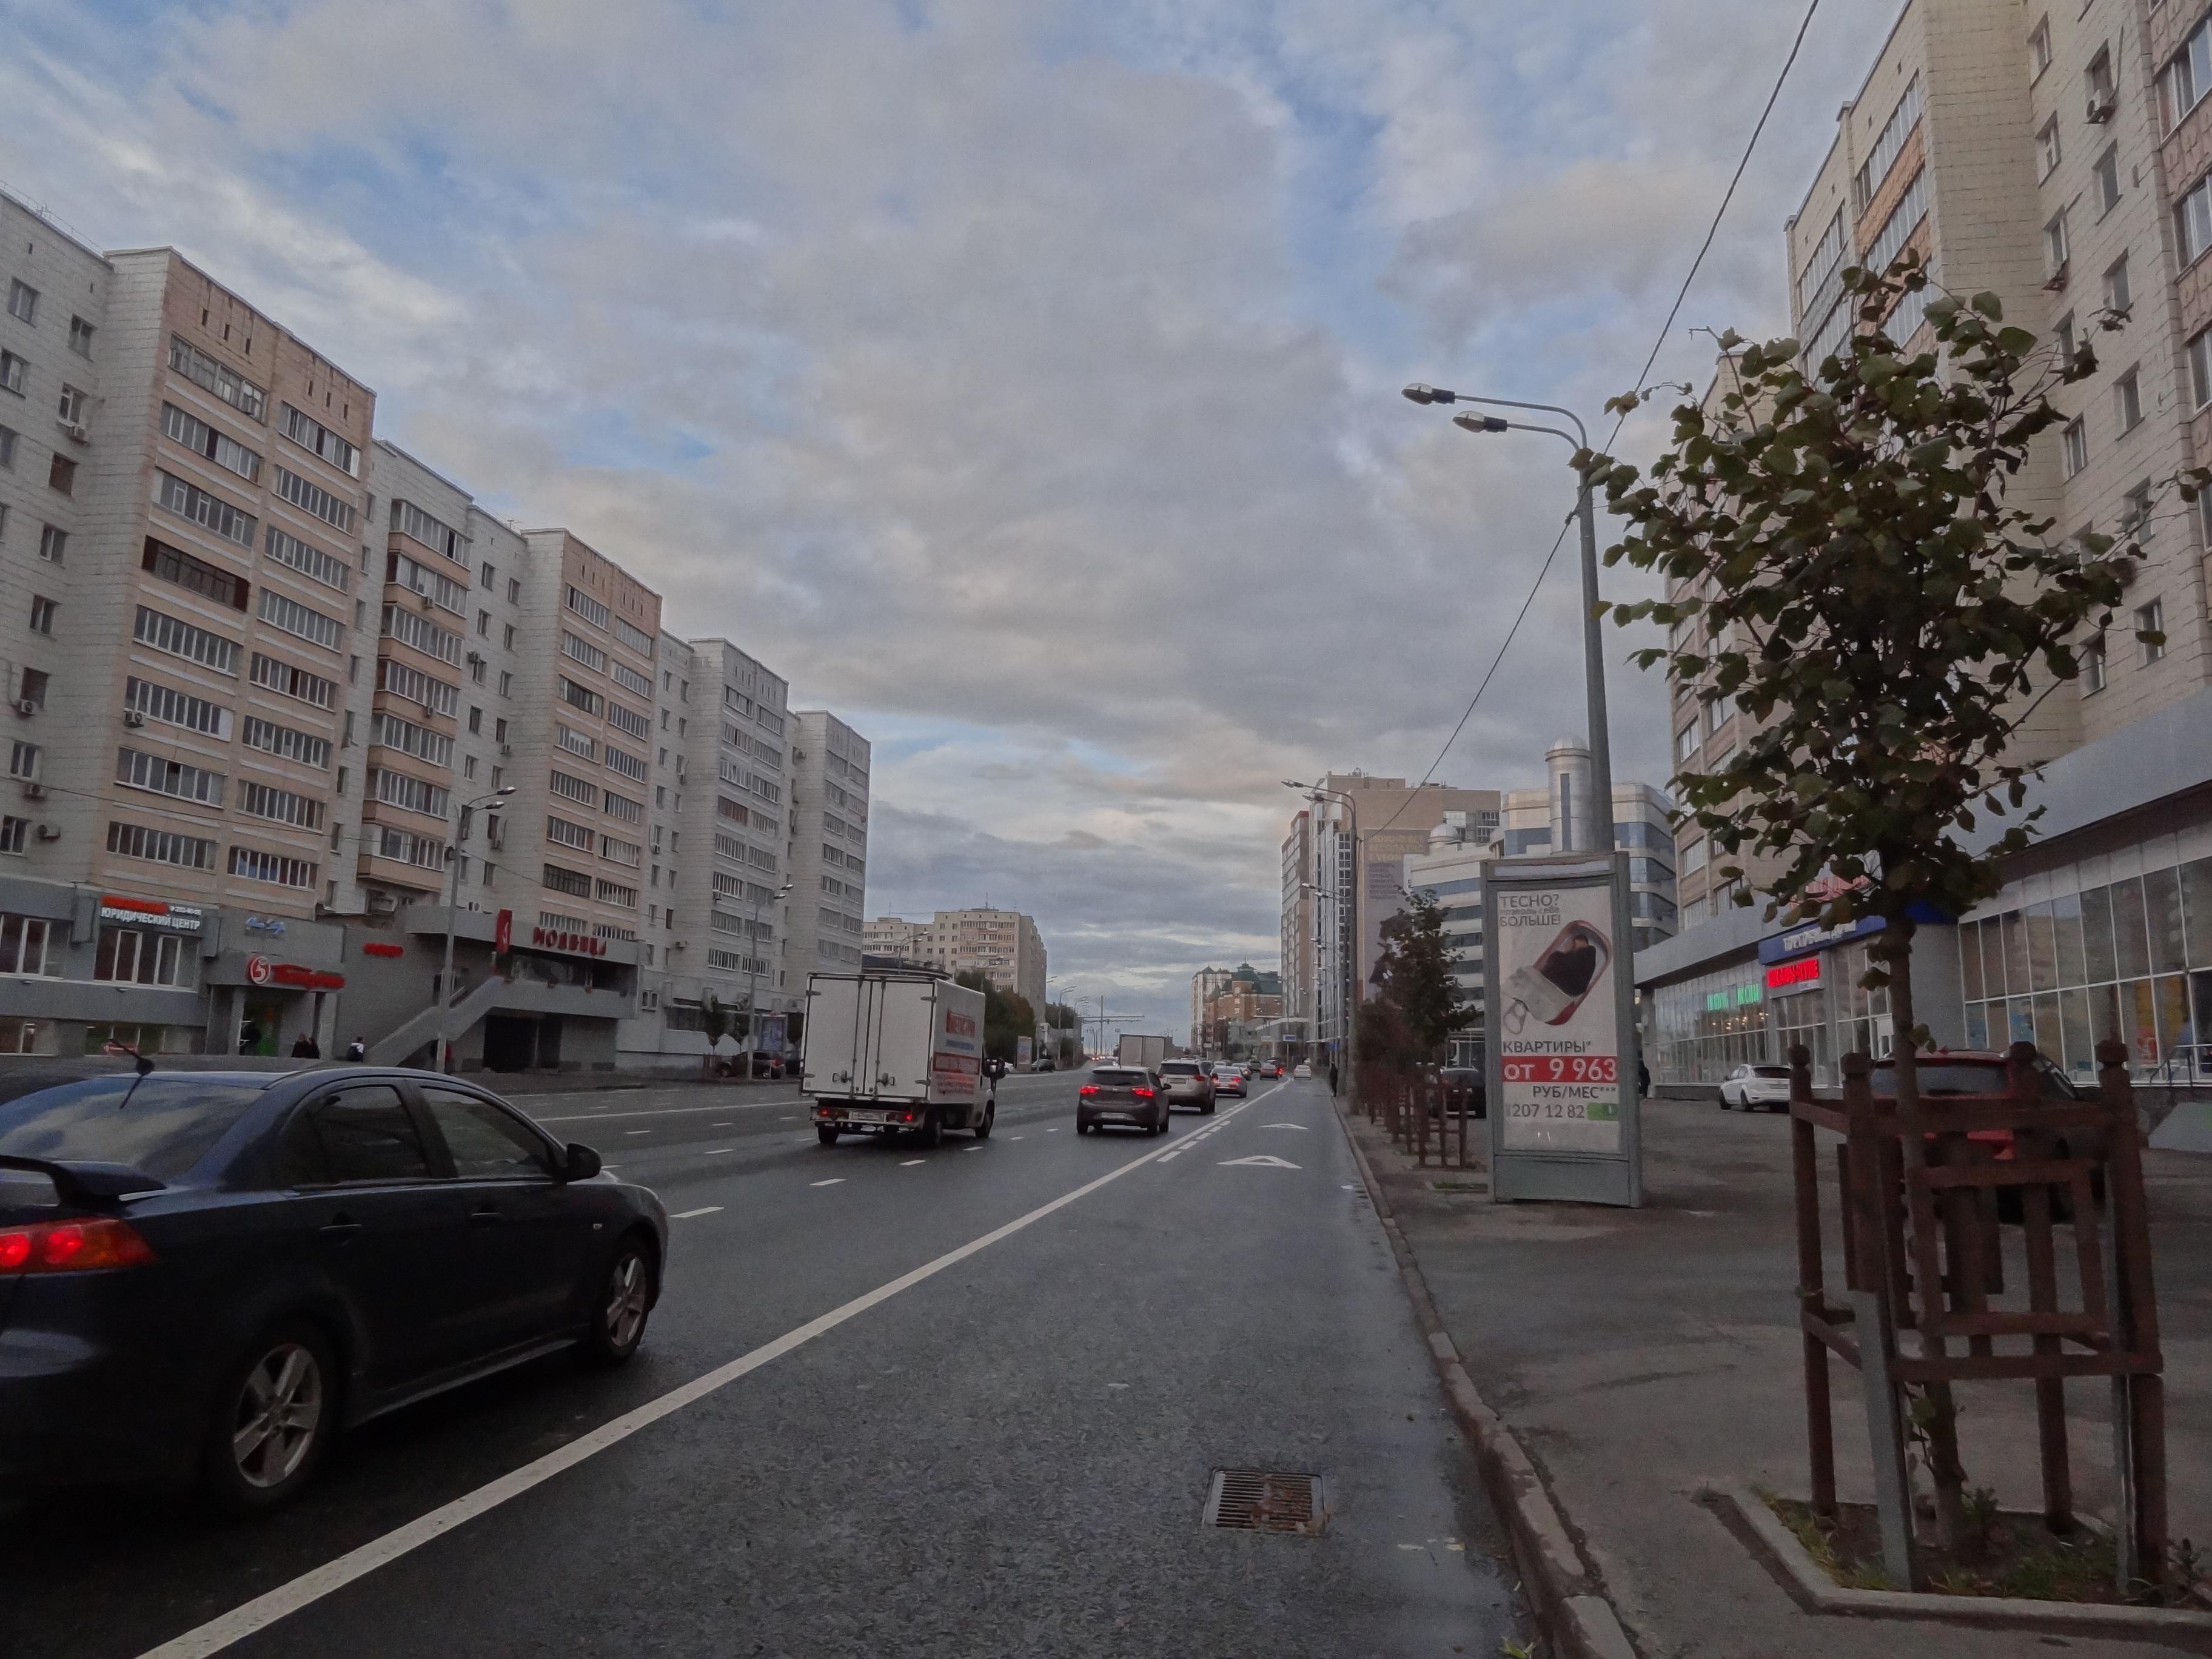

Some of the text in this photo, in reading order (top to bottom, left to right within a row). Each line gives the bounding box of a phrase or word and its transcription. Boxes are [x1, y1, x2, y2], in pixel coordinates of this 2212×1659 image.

[1499, 894, 1560, 908] ТЕСНО?
[101, 907, 171, 927] ЮРИДИЧЕСКИЙ
[172, 917, 201, 930] ЦЕНТР
[1500, 914, 1561, 927] БОЛЬШЕ!
[1572, 1057, 1617, 1081] 963
[1512, 1103, 1585, 1119] 207 12 82
